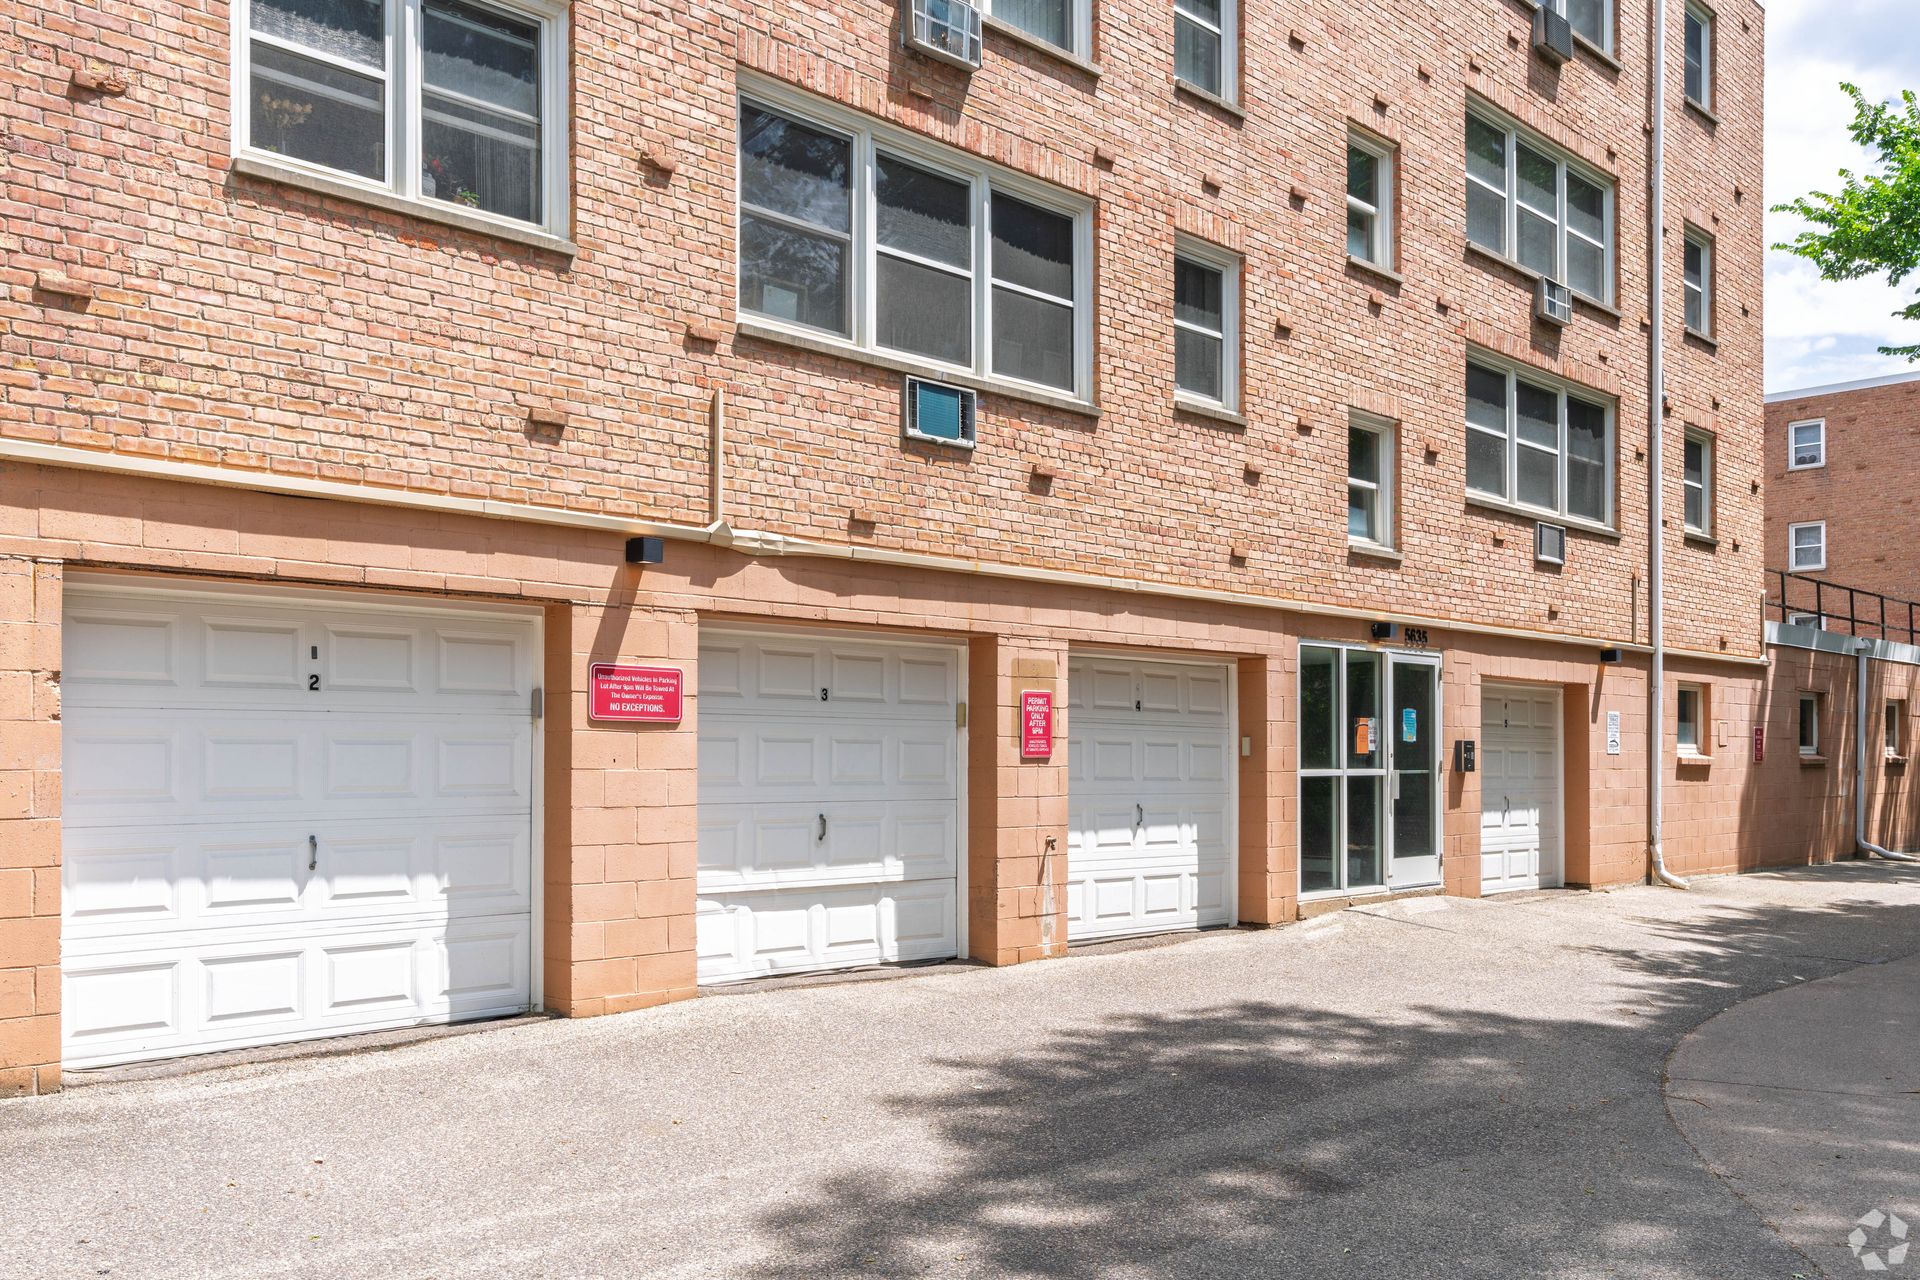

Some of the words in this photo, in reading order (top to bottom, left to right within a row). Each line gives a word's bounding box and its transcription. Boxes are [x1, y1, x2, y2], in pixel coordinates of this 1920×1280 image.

[1405, 628, 1428, 643] 5635
[309, 674, 319, 690] 2
[598, 673, 631, 681] Unauthorized
[658, 677, 677, 685] Parking
[821, 688, 828, 701] 3
[610, 702, 620, 711] NO
[622, 703, 665, 713] EXCEPTIONS.
[1135, 700, 1141, 711] 4
